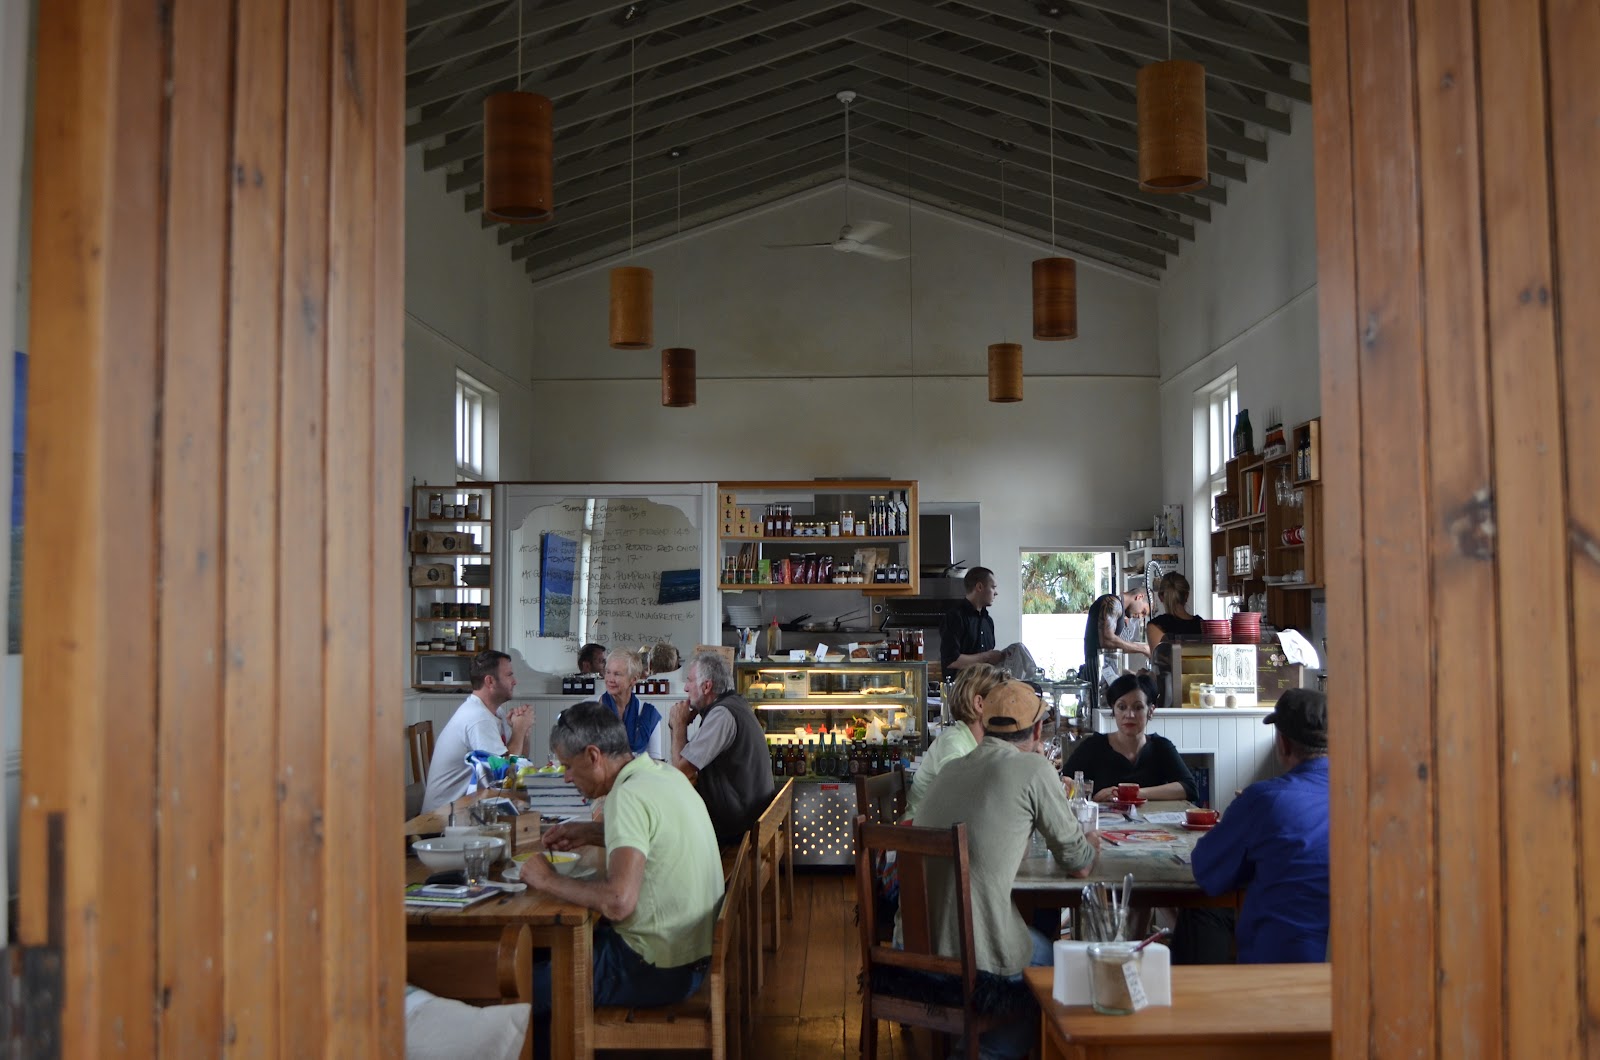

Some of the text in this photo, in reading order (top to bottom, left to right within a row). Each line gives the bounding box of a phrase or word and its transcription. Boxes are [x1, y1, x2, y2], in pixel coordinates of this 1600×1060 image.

[726, 495, 732, 504] t
[590, 512, 613, 520] SOUP
[725, 509, 731, 518] t
[740, 509, 746, 519] t
[725, 524, 731, 533] t
[739, 524, 745, 533] t
[754, 524, 760, 533] t
[625, 543, 653, 552] POTATO
[676, 544, 700, 553] ONION
[616, 571, 651, 580] PUMPKIN
[589, 582, 611, 590] SAGE
[618, 581, 645, 591] GRANA
[520, 596, 541, 606] HOUSE
[601, 597, 639, 606] BEETROOT
[635, 610, 684, 621] VINAIGRETTE
[525, 630, 535, 639] MT
[612, 632, 634, 642] PORK
